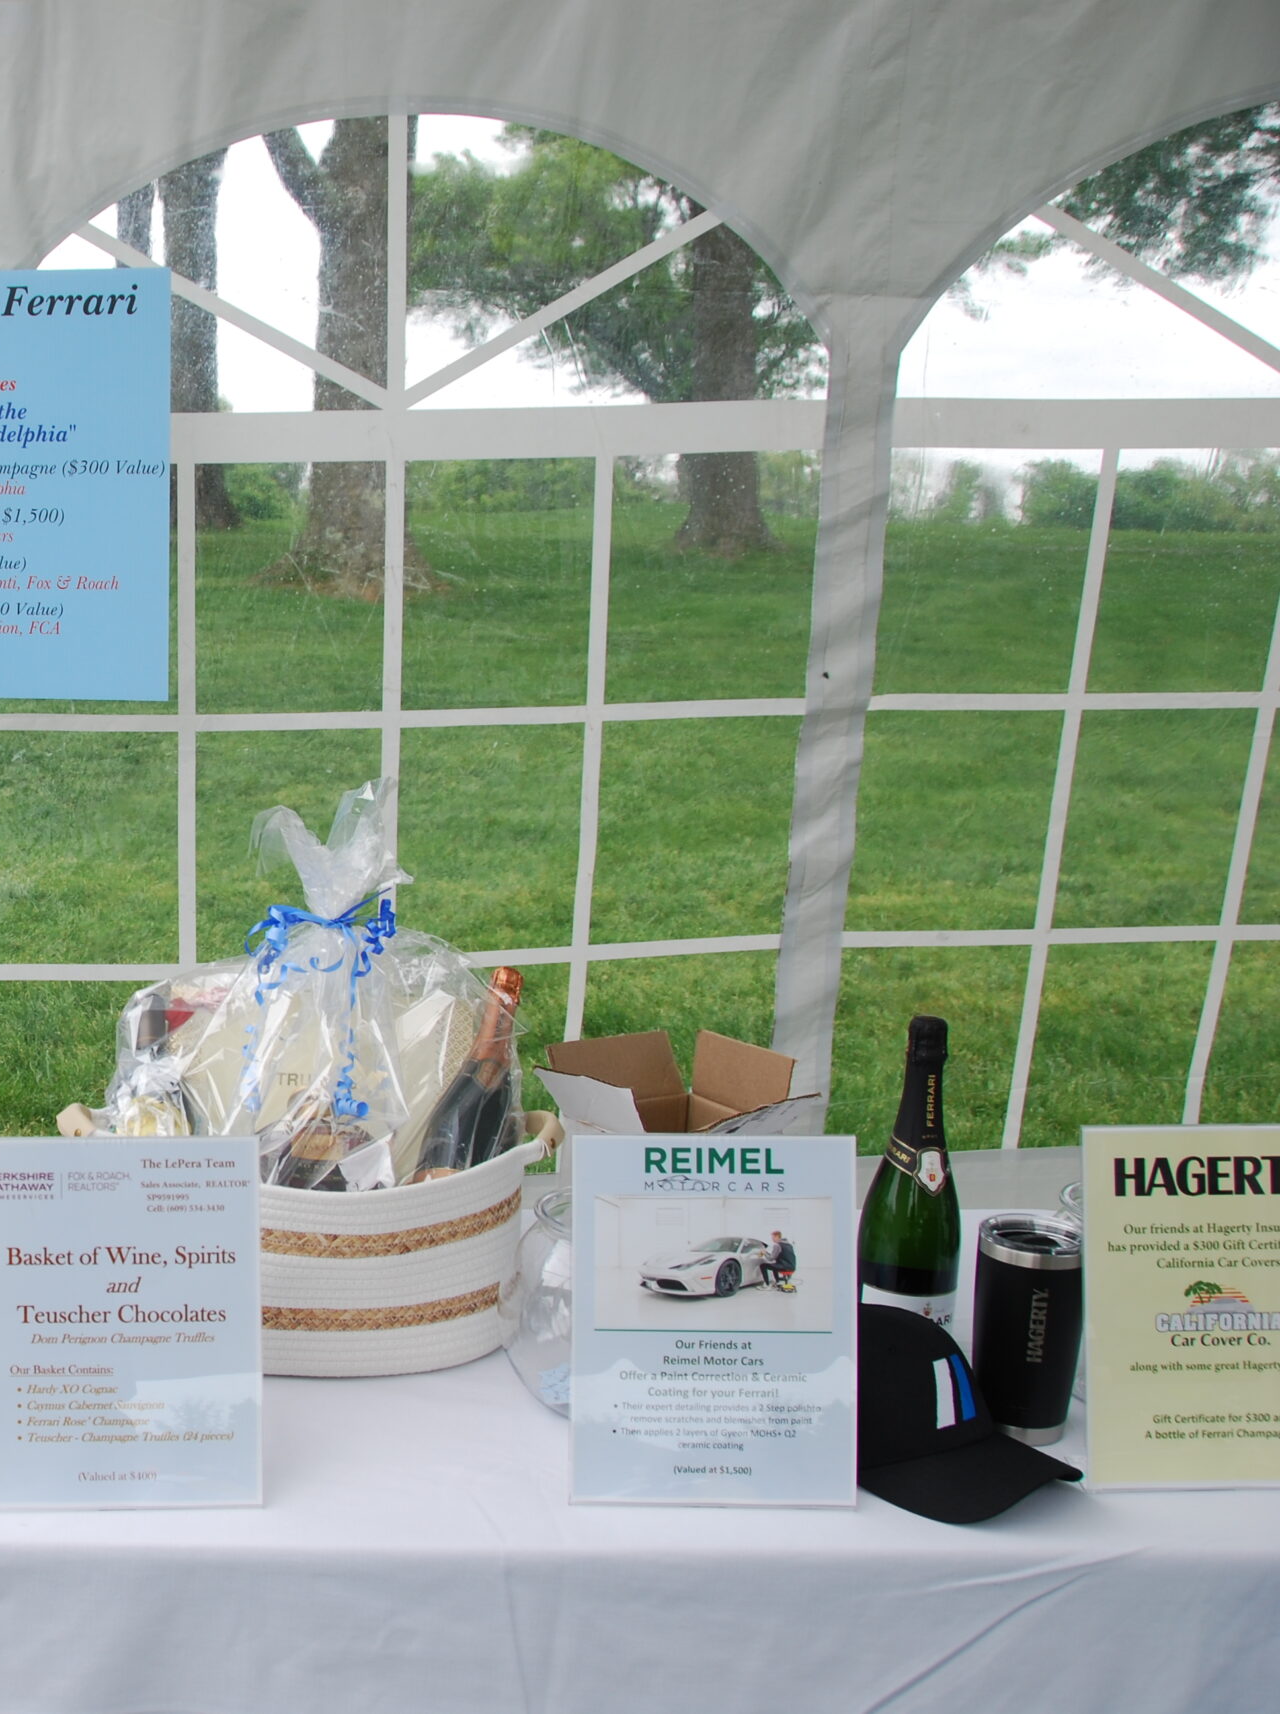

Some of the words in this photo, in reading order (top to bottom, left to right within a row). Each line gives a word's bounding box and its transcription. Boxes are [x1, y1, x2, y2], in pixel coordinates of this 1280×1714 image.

[0, 284, 138, 317] Ferrari
[62, 459, 110, 477] ($300
[116, 459, 165, 478] Value)
[1, 507, 65, 526] $1,500)
[26, 575, 52, 590] Fox
[56, 575, 72, 590] &
[76, 575, 119, 590] Roach
[926, 1074, 937, 1128] FERRARI
[142, 1159, 162, 1169] The
[165, 1158, 202, 1169] LePera
[205, 1158, 235, 1168] Team
[644, 1147, 785, 1175] REIMEL
[68, 1172, 86, 1181] FOX
[89, 1173, 96, 1181] &
[98, 1172, 131, 1183] ROACH,
[1123, 1223, 1147, 1235] Our
[1150, 1222, 1191, 1235] friends
[1192, 1224, 1204, 1234] at
[1207, 1222, 1251, 1237] Hagerty
[1107, 1241, 1127, 1252] has
[1129, 1240, 1181, 1255] provided
[1183, 1243, 1190, 1251] a
[1193, 1240, 1220, 1252] $300
[1223, 1239, 1247, 1251] Gift
[7, 1247, 72, 1266] Basket
[79, 1246, 102, 1265] of
[105, 1246, 168, 1267] Wine,
[174, 1245, 236, 1269] Spirits
[106, 1276, 142, 1294] and
[16, 1304, 112, 1324] Teuscher
[117, 1303, 226, 1324] Chocolates
[675, 1339, 696, 1349] Our
[698, 1340, 738, 1350] Friends
[740, 1341, 752, 1350] at
[1170, 1334, 1196, 1347] Car
[1200, 1333, 1243, 1347] Cover
[1246, 1332, 1271, 1346] Co.
[663, 1355, 701, 1366] Reimel
[703, 1355, 738, 1366] Motor
[740, 1356, 764, 1366] Cars
[9, 1365, 29, 1375] Our
[33, 1364, 65, 1375] Basket
[68, 1363, 114, 1375] Contains:
[26, 1384, 57, 1395] Hardy
[60, 1384, 80, 1394] XO
[81, 1384, 119, 1396] Cognac
[1152, 1414, 1173, 1424] Gift
[1174, 1414, 1226, 1424] Certificate
[1228, 1413, 1243, 1423] for
[1245, 1412, 1271, 1423] $300
[673, 1465, 707, 1475] (Valued
[708, 1466, 717, 1474] at
[719, 1465, 752, 1476] $1,500)
